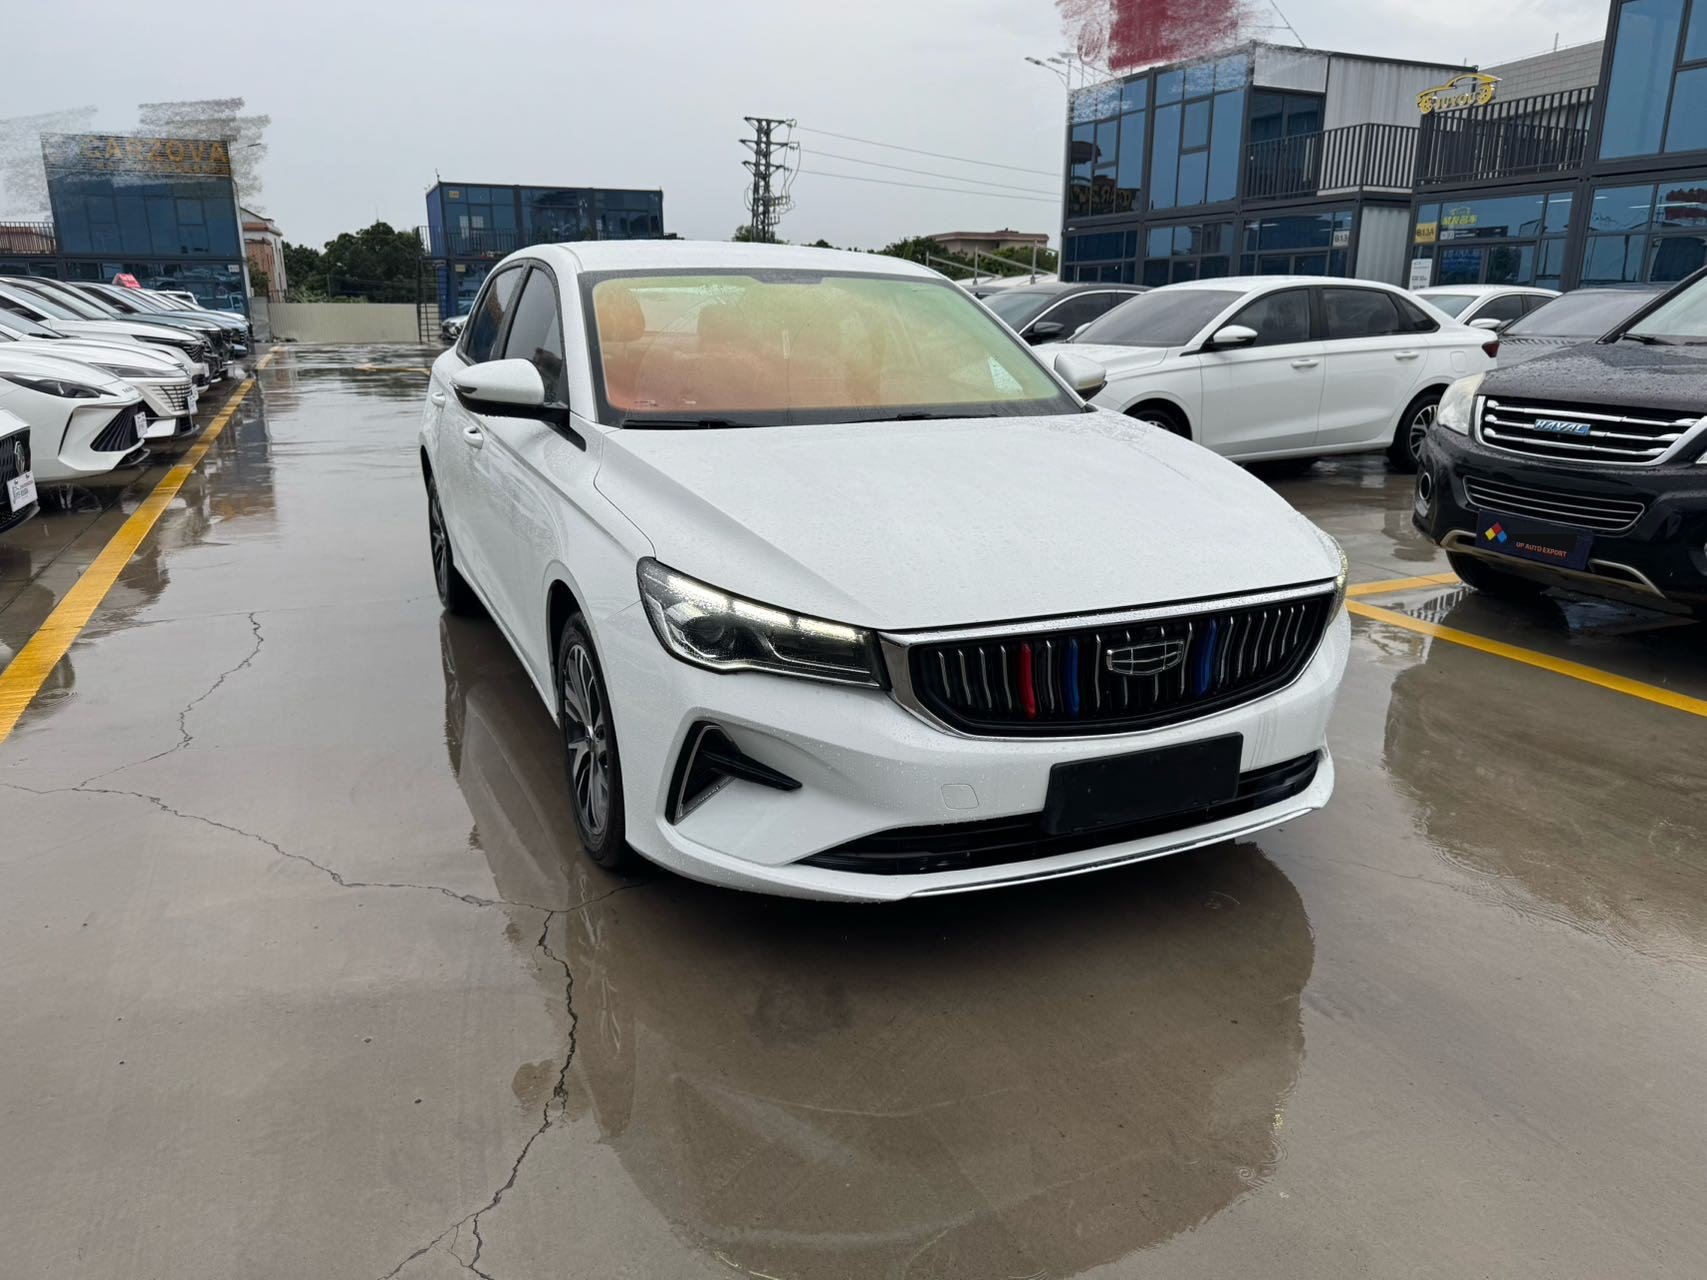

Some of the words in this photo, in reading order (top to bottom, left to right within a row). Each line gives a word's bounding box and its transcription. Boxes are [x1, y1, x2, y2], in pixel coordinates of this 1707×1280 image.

[1516, 541, 1525, 549] UP
[1525, 543, 1542, 552] AUTO
[1542, 546, 1568, 558] EXPORT
